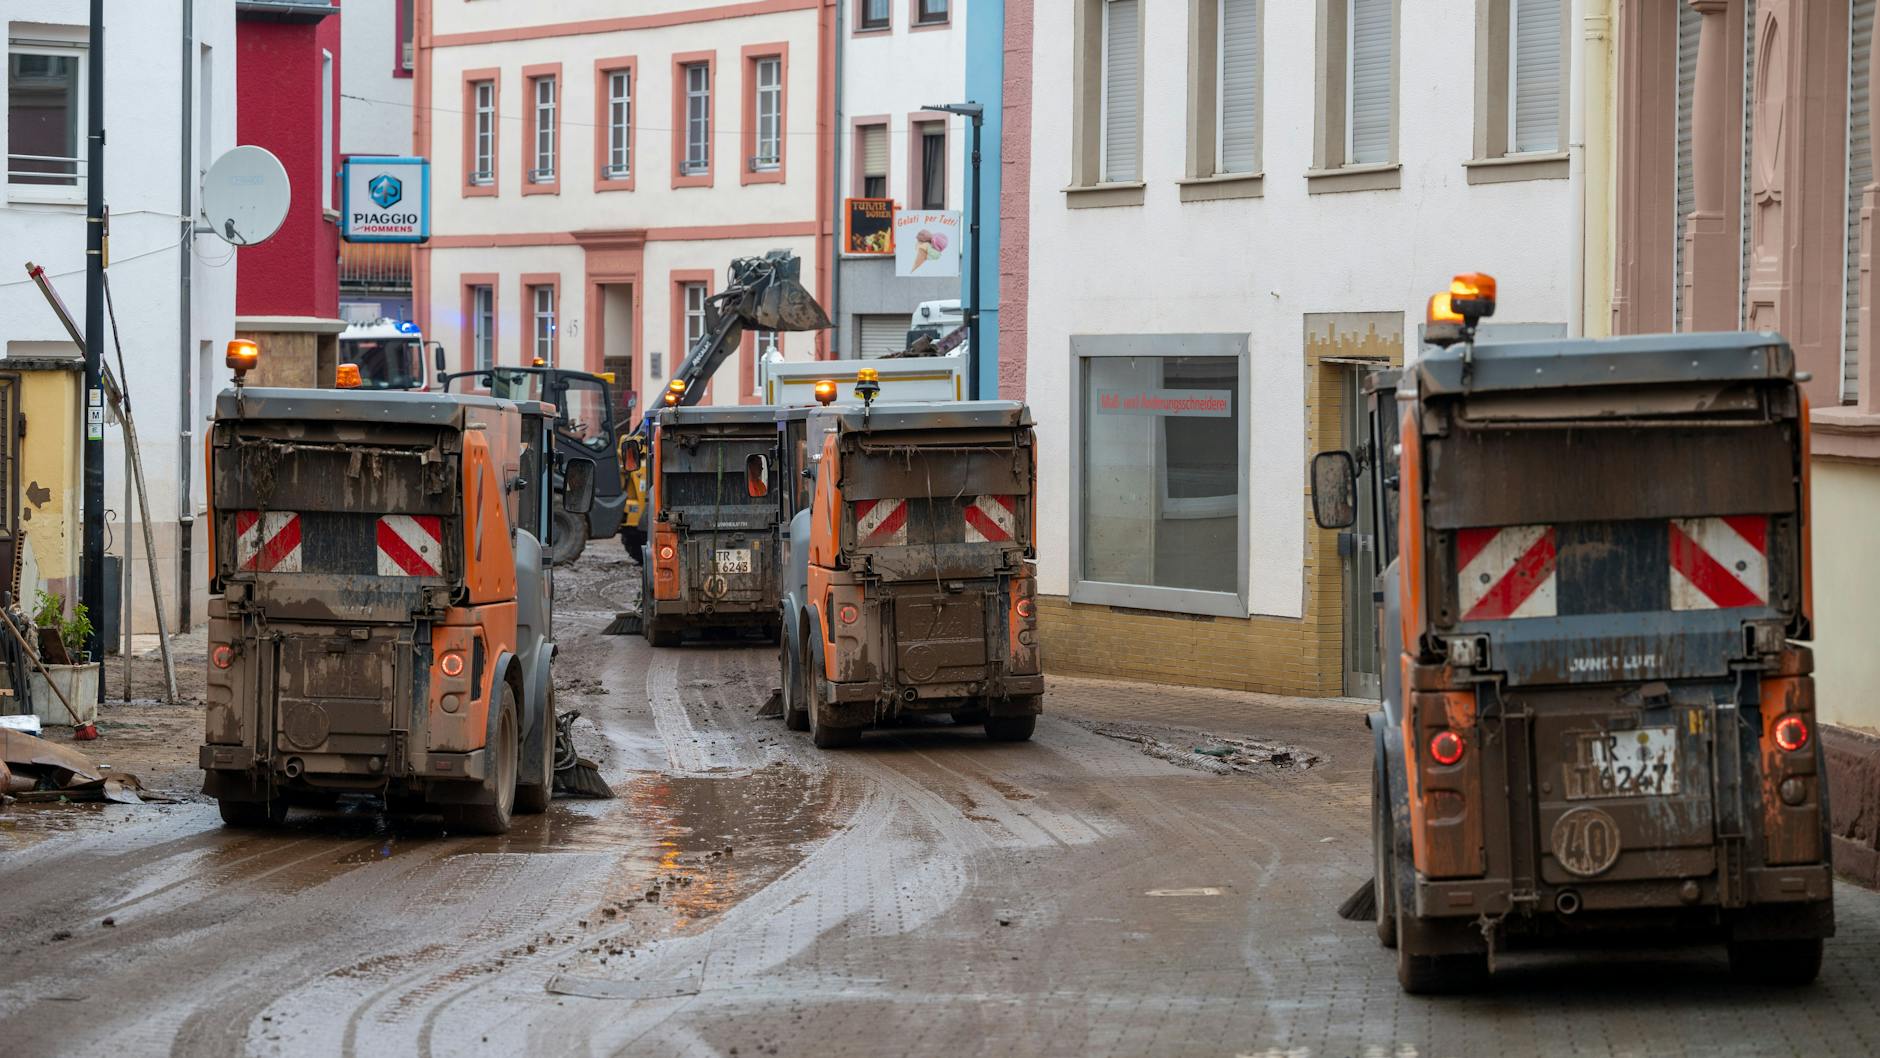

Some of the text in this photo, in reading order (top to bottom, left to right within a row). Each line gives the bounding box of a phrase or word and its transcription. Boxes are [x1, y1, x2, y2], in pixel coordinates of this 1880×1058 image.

[353, 213, 418, 224] PIAGGIO
[897, 214, 919, 227] Gelati
[924, 215, 937, 226] per
[717, 551, 730, 561] TR
[1600, 763, 1669, 794] 6247
[1562, 818, 1610, 870] 40
